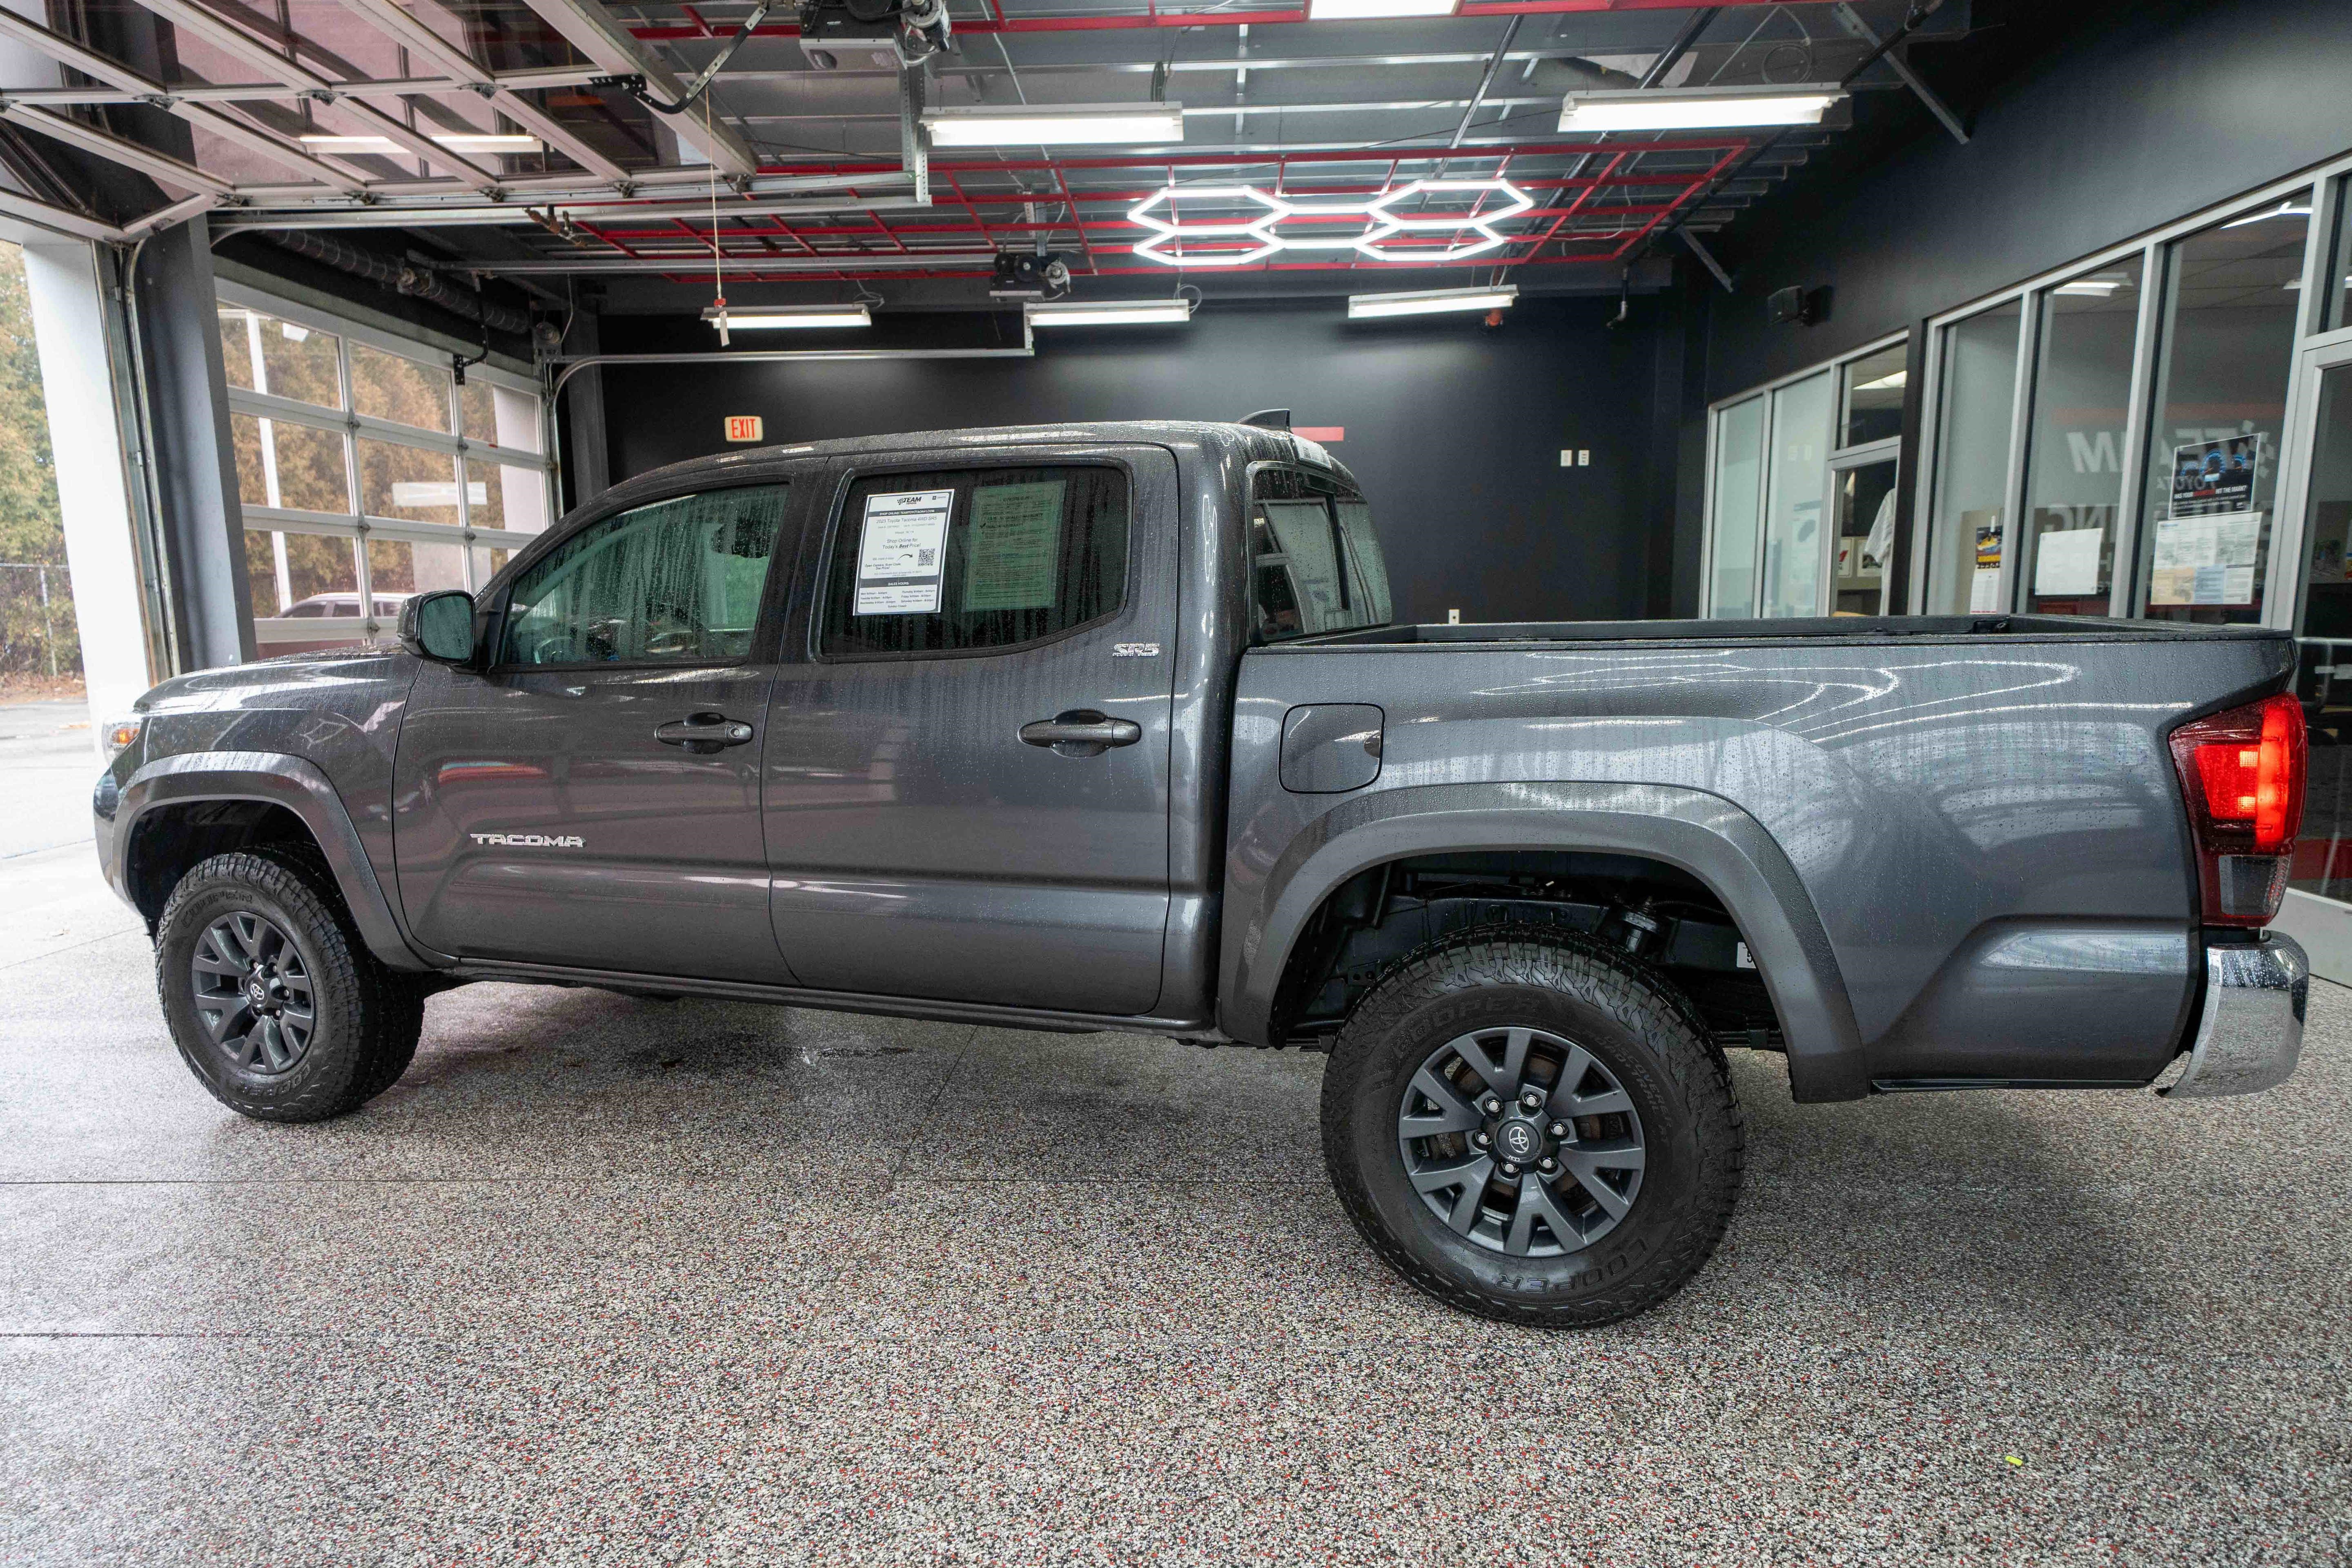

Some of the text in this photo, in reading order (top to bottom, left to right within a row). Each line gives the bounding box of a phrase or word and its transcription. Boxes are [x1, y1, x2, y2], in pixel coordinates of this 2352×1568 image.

[731, 419, 755, 438] EXIT
[1112, 643, 1160, 657] SR5
[470, 834, 584, 848] TACOMA
[1494, 1238, 1648, 1294] COOPER
